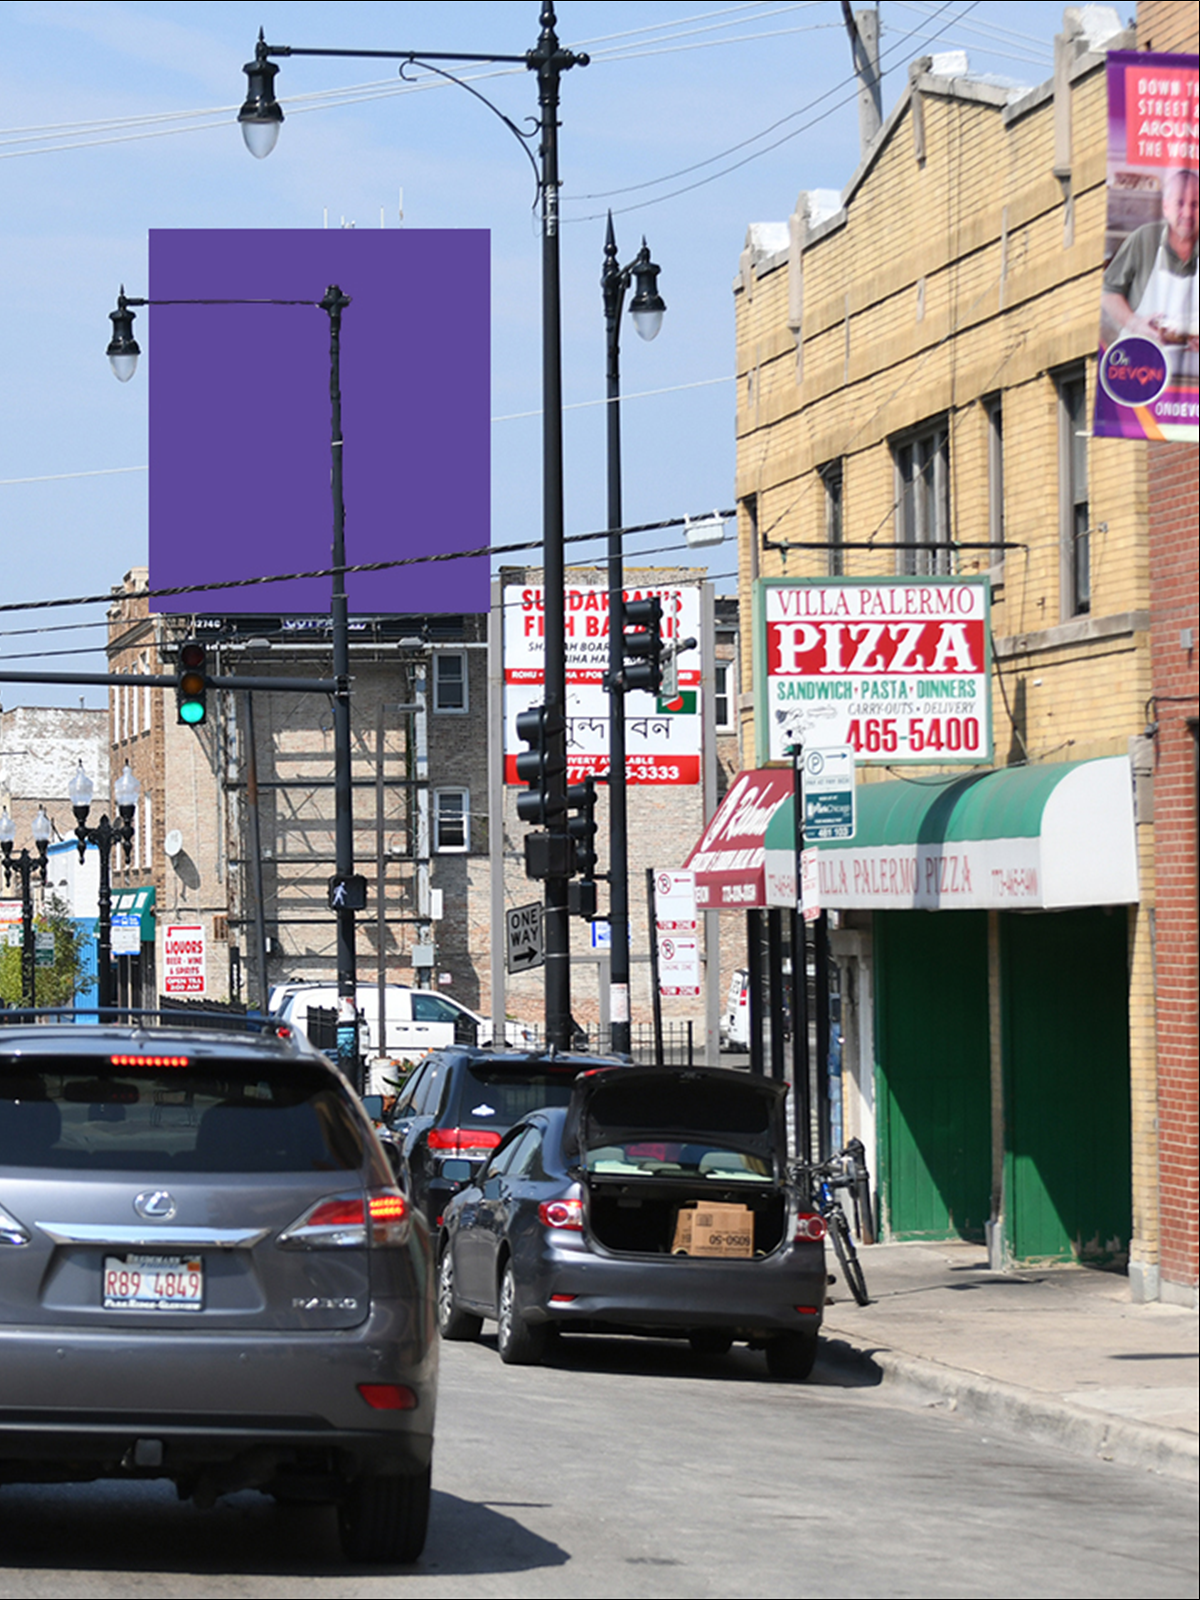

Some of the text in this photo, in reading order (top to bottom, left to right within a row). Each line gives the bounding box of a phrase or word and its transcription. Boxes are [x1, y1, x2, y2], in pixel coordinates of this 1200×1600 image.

[1138, 78, 1180, 96] DOWN
[1138, 98, 1189, 117] STREET
[1138, 140, 1162, 157] THE
[1110, 349, 1128, 366] On
[1108, 365, 1164, 386] DEVON
[776, 586, 974, 616] VILLA PALERMO
[524, 616, 575, 637] FIH
[773, 622, 978, 674] PIZZA
[511, 671, 537, 679] ROHU
[777, 679, 977, 701] SANDWICH PASTA DINNERS
[923, 701, 976, 715] DELIVERY
[845, 717, 980, 753] 465-5400
[819, 861, 849, 895] ILLA
[854, 858, 920, 895] PALERMO
[926, 855, 973, 894] PIZZA
[511, 908, 538, 930] ONE
[511, 926, 539, 947] WAY
[165, 940, 203, 956] LIQUORS
[106, 1271, 200, 1298] R89 4849
